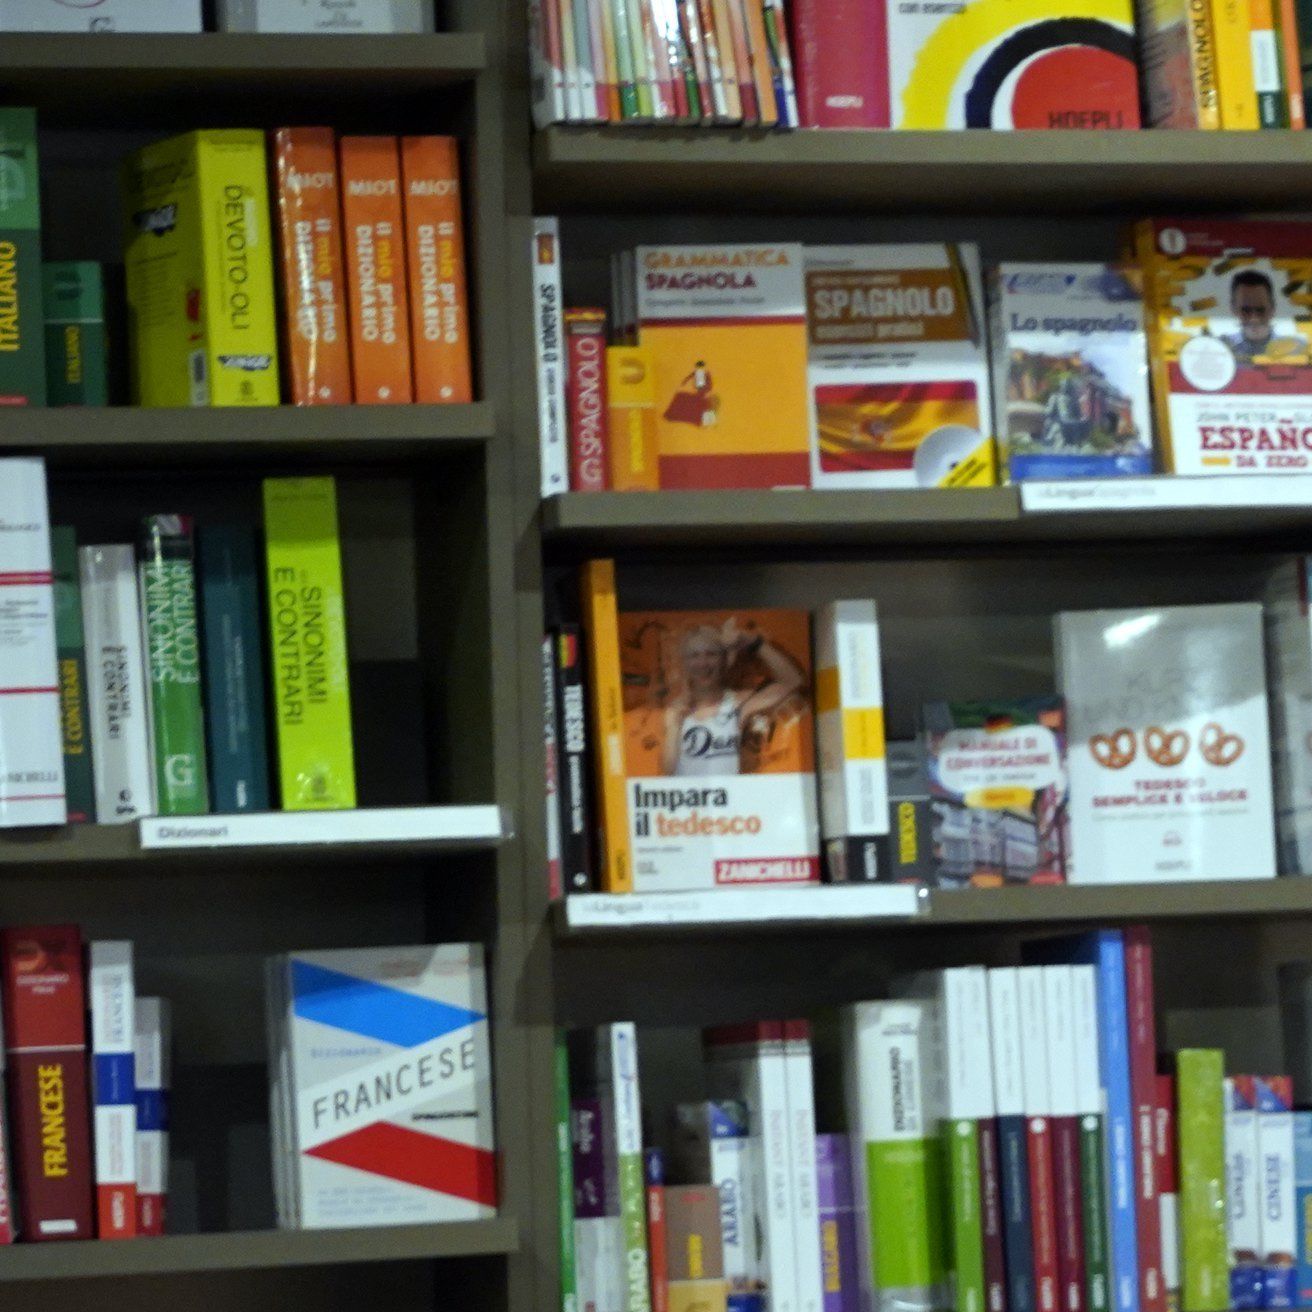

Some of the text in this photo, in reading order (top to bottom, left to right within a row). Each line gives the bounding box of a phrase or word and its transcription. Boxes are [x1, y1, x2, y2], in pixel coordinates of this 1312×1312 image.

[354, 224, 377, 342] DIZIONARIO
[417, 224, 439, 342] DIZIONARIO
[643, 250, 790, 269] GRAMMATICA
[645, 271, 758, 291] SPAGNOLA
[318, 279, 338, 344] primo
[378, 283, 397, 345] primo
[440, 282, 458, 344] primo
[813, 285, 956, 321] SPAGNOLO
[572, 336, 603, 457] SPAGNOLO
[273, 565, 304, 726] E CONTRARI
[301, 586, 328, 705] SINONIMI
[634, 783, 729, 814] Impara
[636, 811, 762, 838] il tedesco
[310, 1036, 477, 1130] FRANCESE
[37, 1063, 69, 1178] FRANCESE
